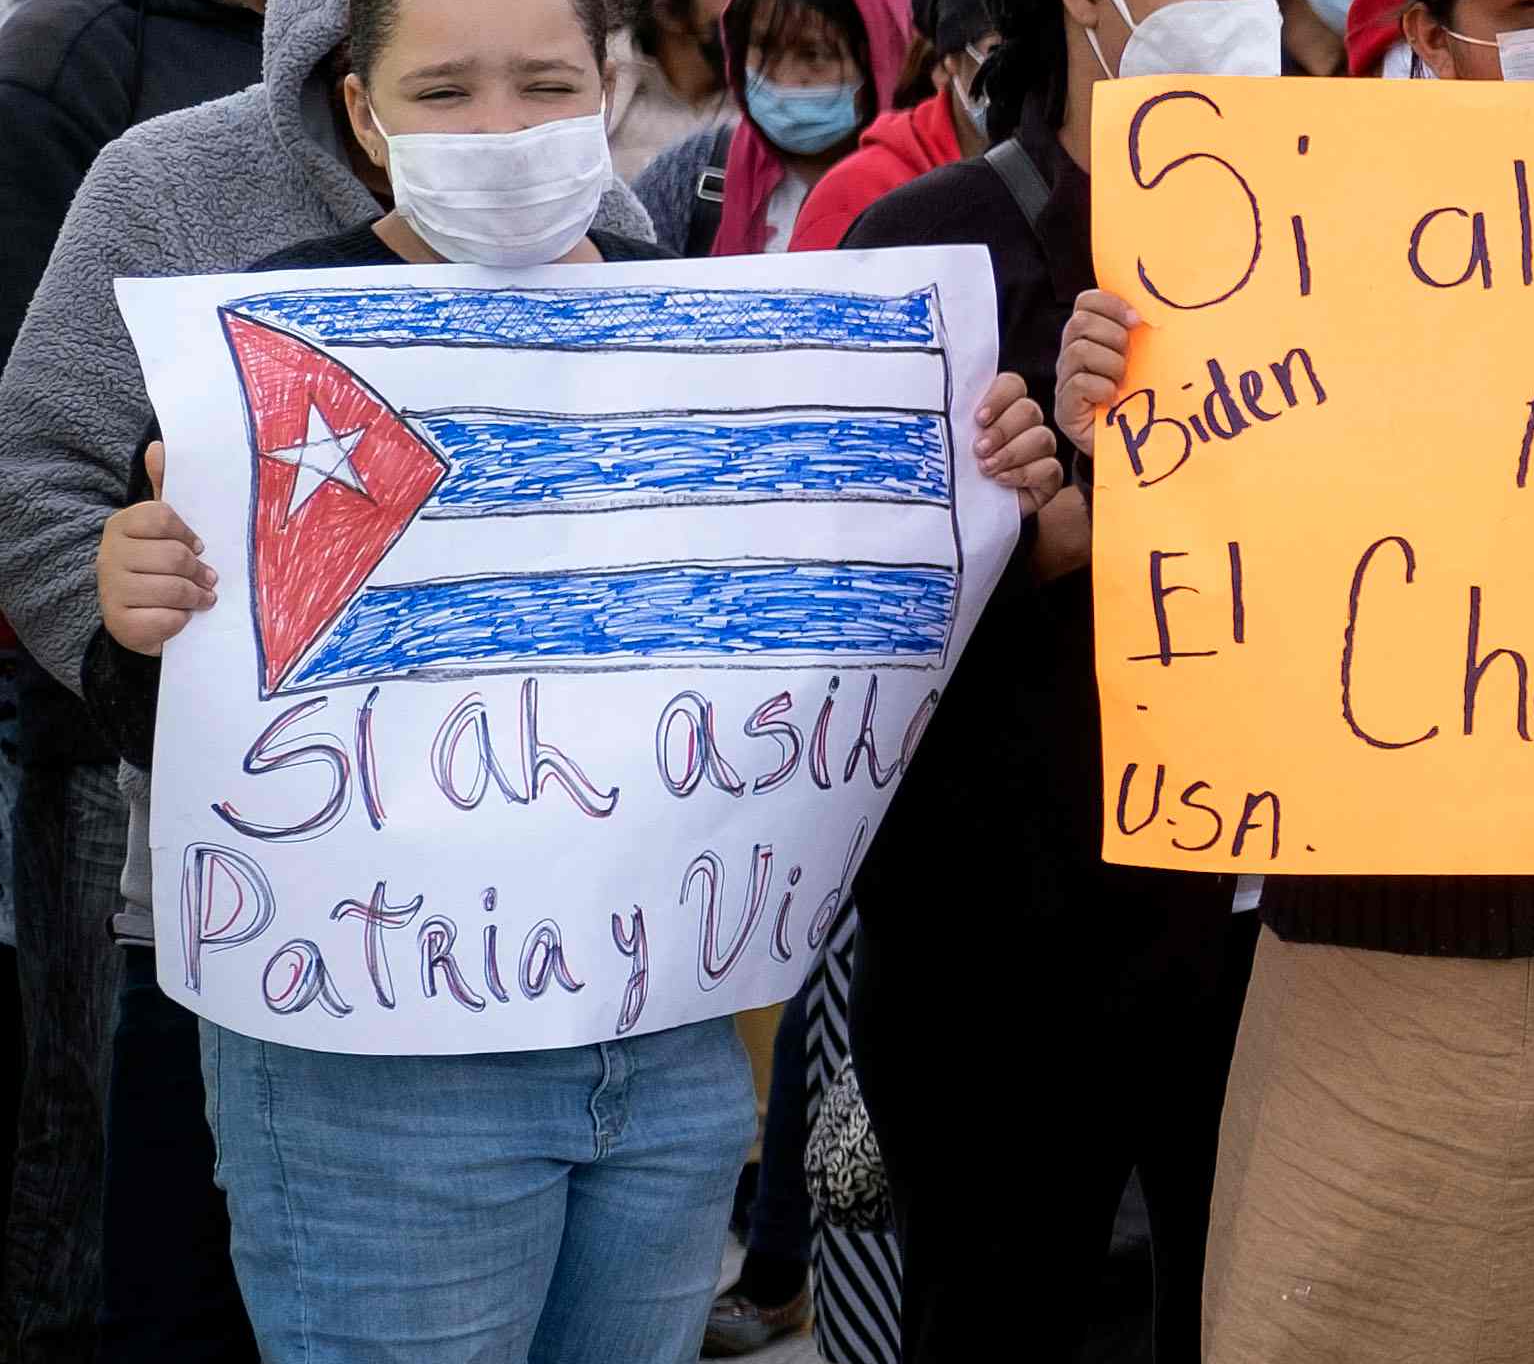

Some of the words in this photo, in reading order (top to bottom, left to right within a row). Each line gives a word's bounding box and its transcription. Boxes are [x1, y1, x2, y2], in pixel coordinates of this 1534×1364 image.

[1129, 91, 1310, 309] Si
[1408, 160, 1532, 289] al
[1107, 347, 1327, 488] Biden
[612, 904, 649, 1036] y
